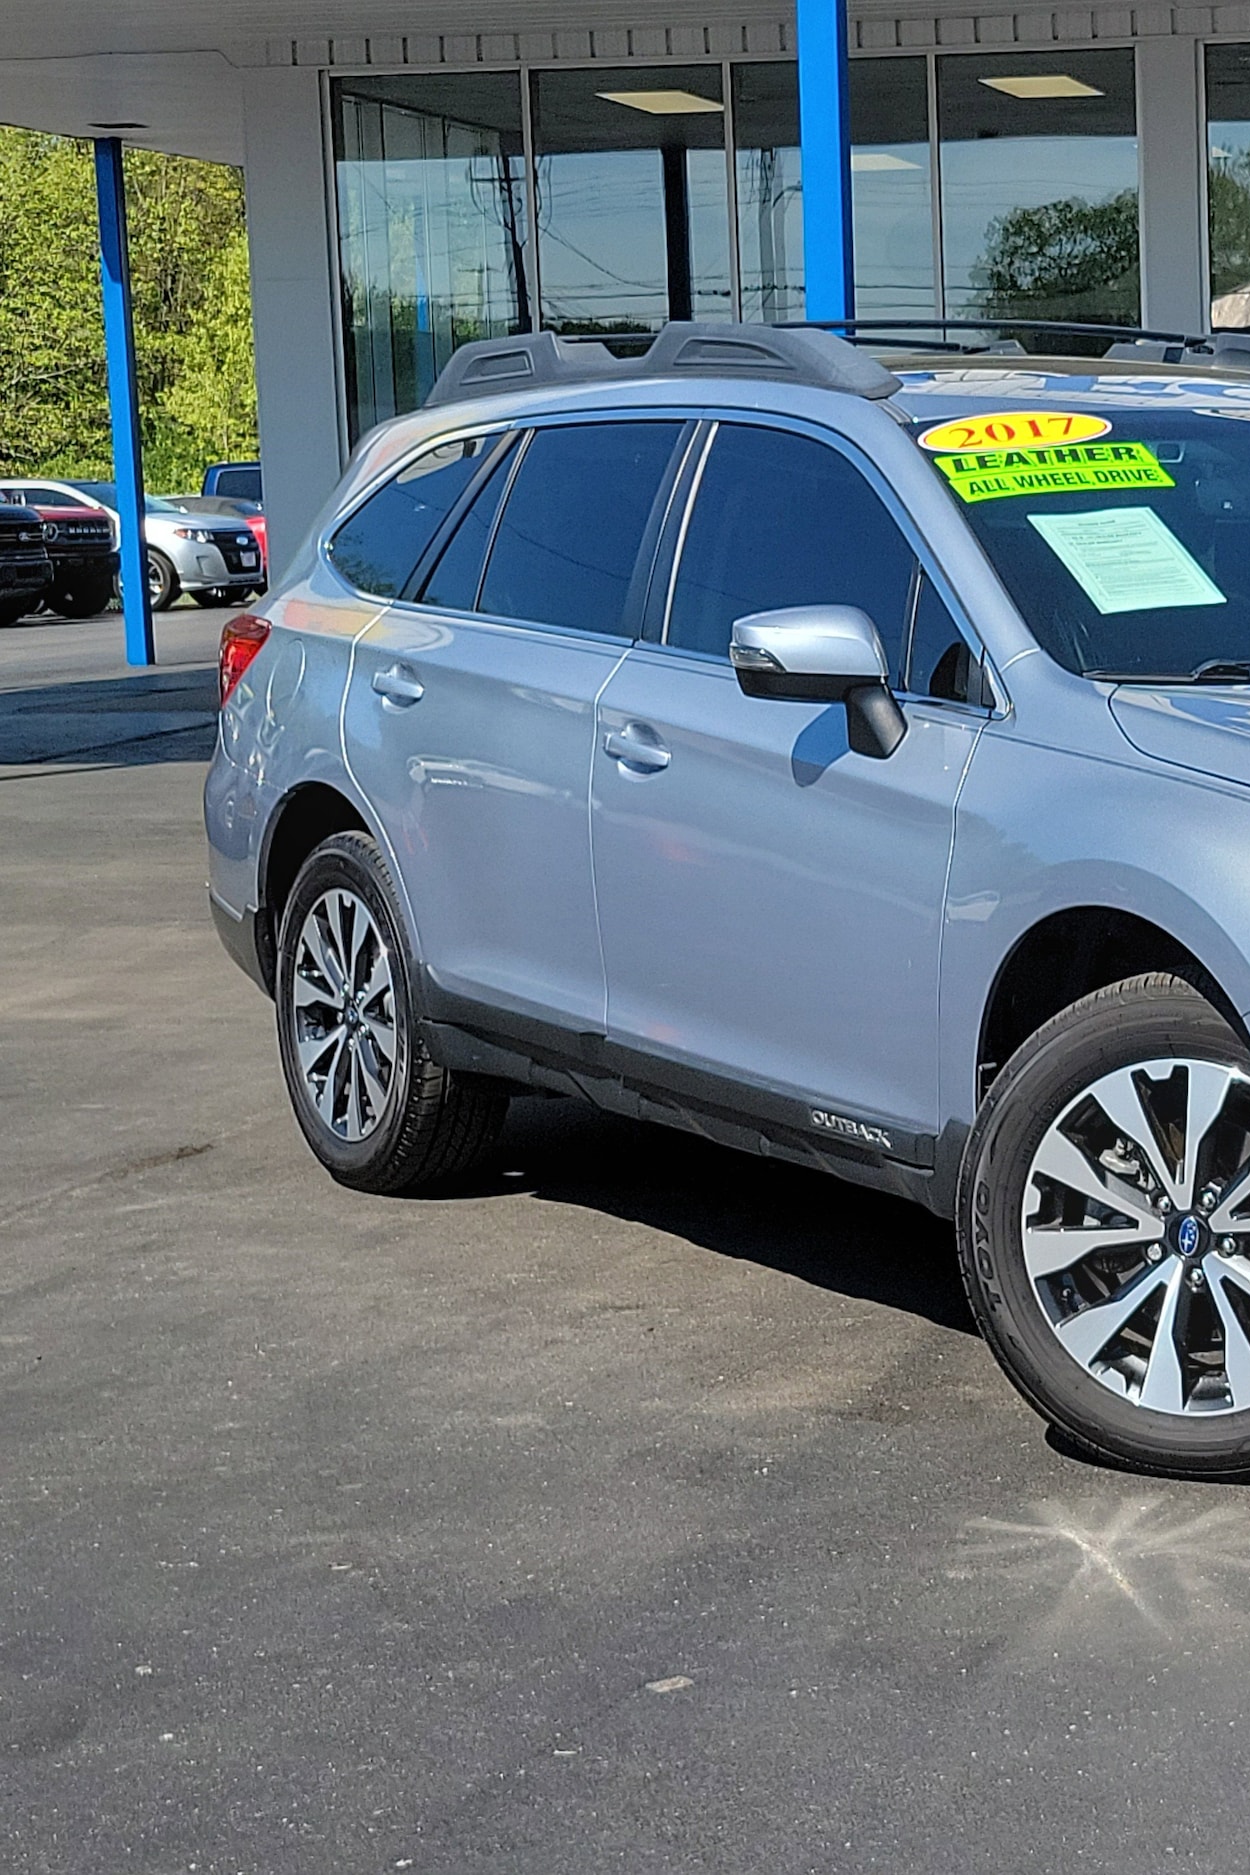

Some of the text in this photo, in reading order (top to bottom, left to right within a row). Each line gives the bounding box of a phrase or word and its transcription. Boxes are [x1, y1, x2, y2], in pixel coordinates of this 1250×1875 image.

[949, 417, 1073, 448] 2017
[953, 446, 1138, 473] LEATHER
[969, 468, 1158, 496] ALL WHEEL DRIVE
[811, 1109, 893, 1150] OUTBACK
[975, 1180, 1002, 1312] TOYO
